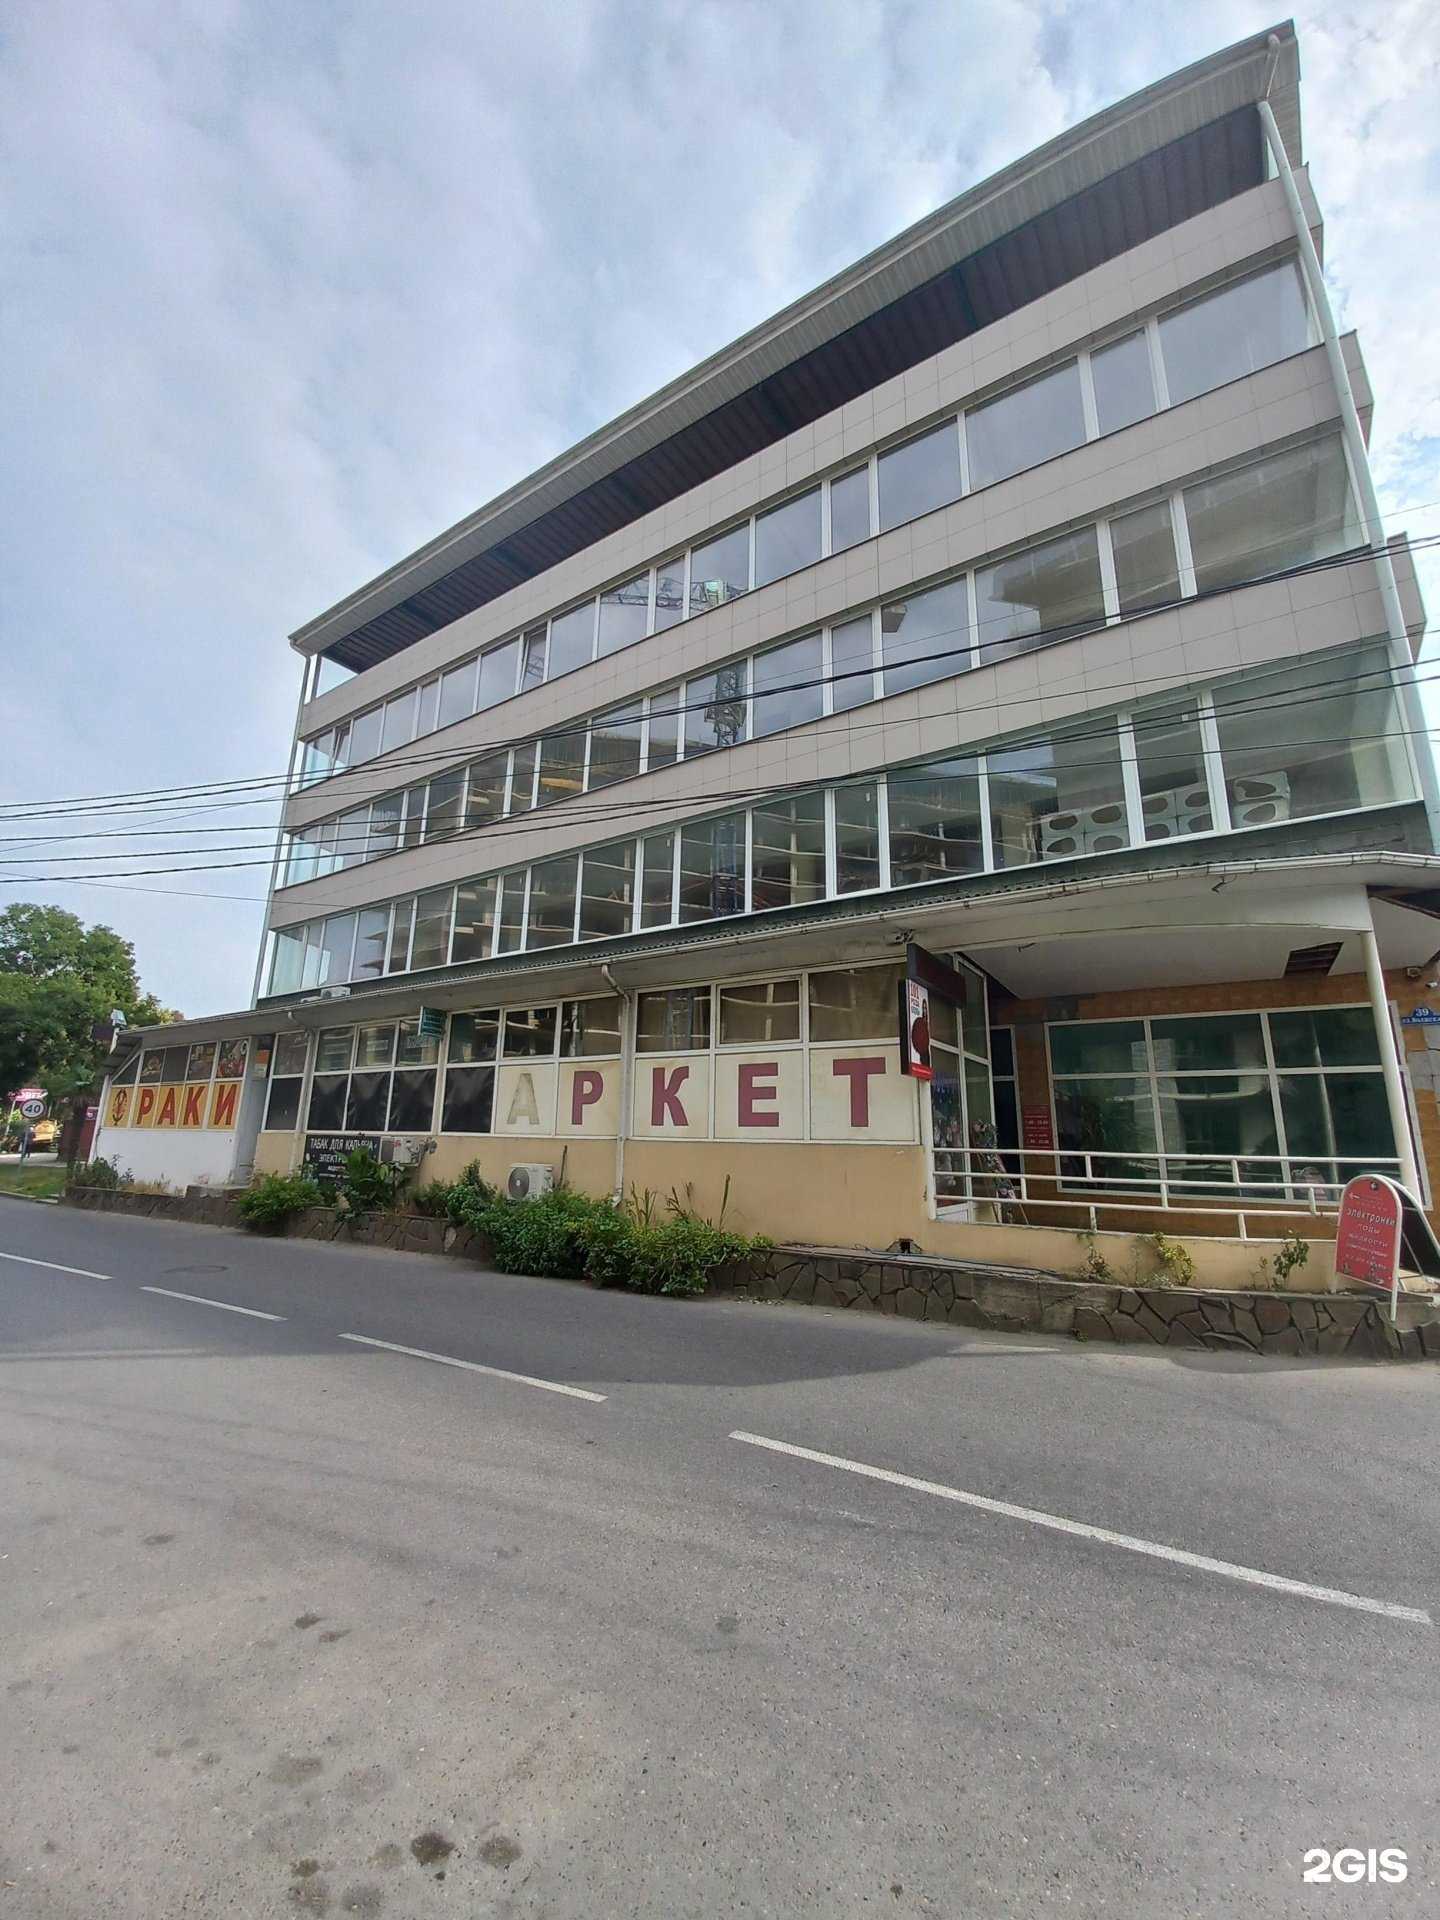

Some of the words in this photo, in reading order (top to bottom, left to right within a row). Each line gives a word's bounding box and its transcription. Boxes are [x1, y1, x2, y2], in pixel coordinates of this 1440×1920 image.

[1415, 1008, 1429, 1017] 39
[507, 1056, 887, 1128] АРКЕТ
[25, 1104, 41, 1114] 40
[136, 1084, 237, 1125] РАКИ
[310, 1137, 329, 1150] ТАБАК
[329, 1138, 344, 1151] ДЛЯ
